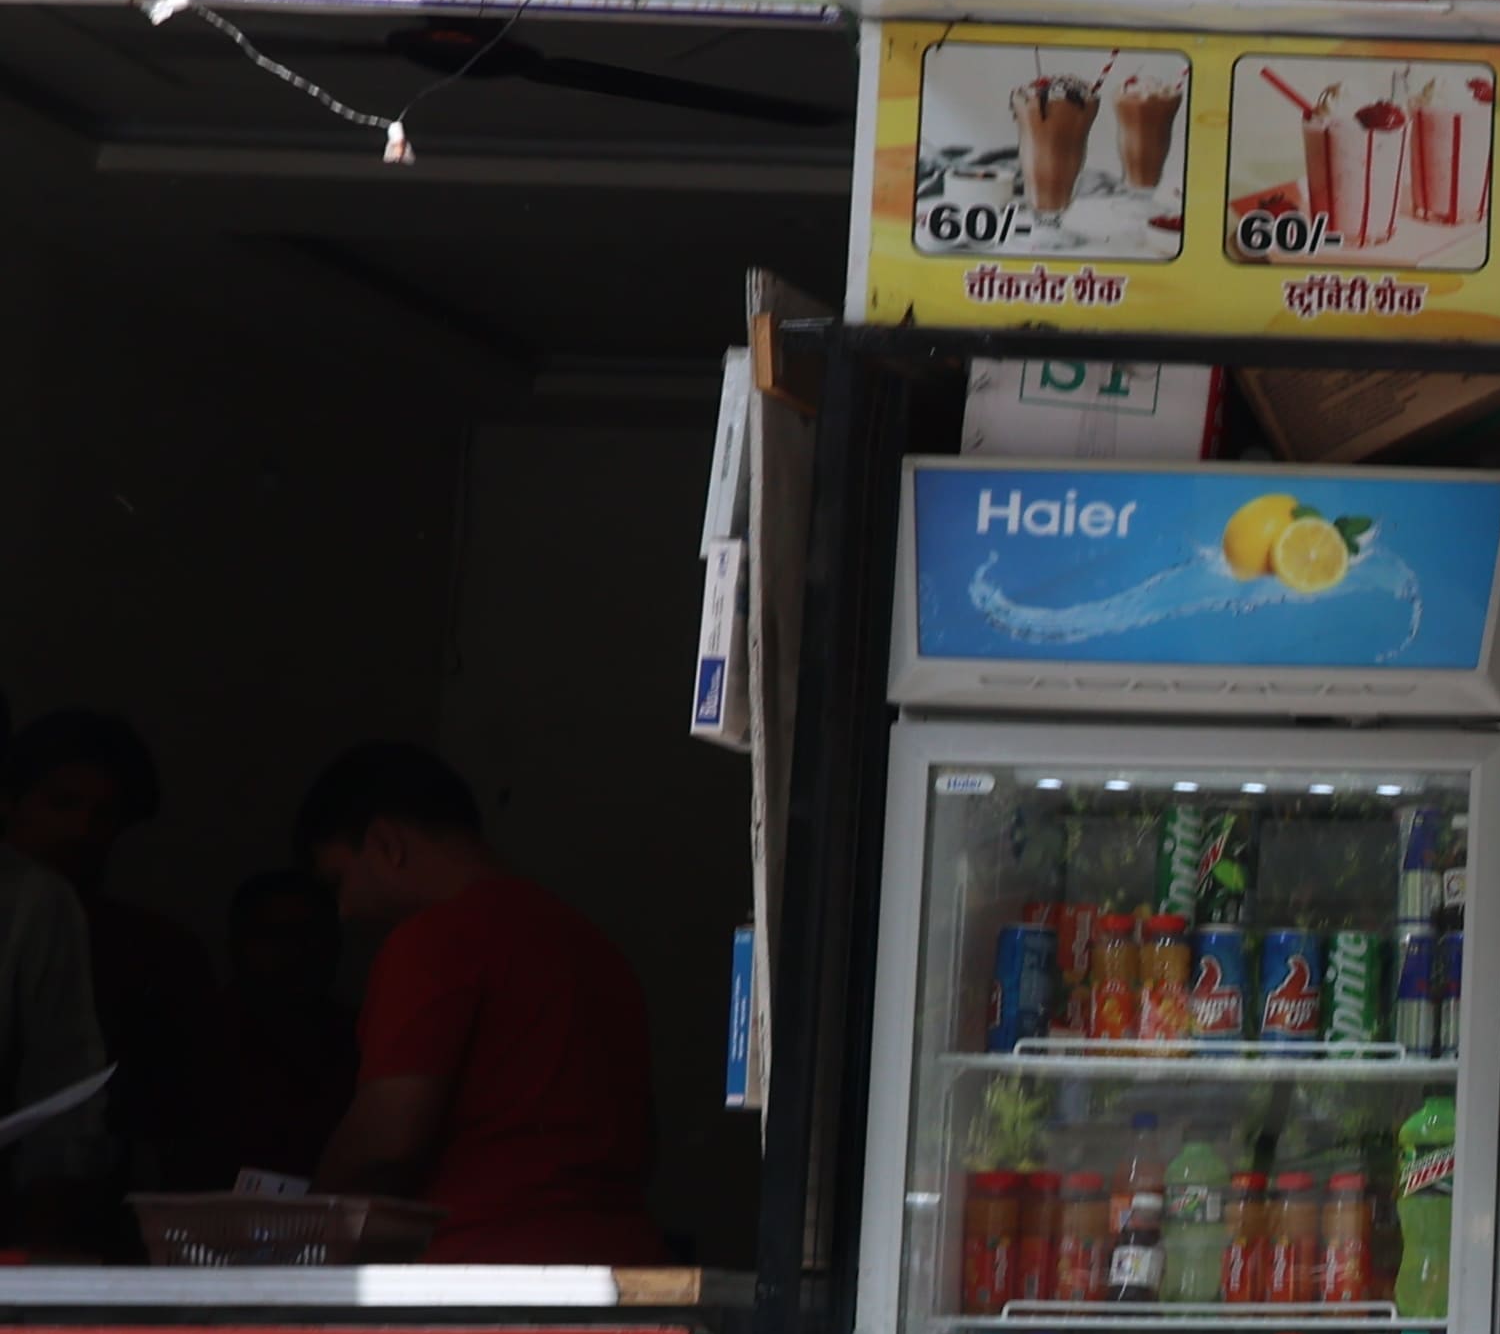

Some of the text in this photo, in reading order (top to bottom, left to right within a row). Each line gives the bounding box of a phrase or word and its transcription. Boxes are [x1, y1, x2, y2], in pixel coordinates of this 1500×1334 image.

[927, 201, 1033, 246] 60/-
[1238, 210, 1343, 255] 60/-
[1073, 269, 1127, 308] शेक
[1374, 276, 1428, 316] शेक
[975, 488, 1138, 540] Haier
